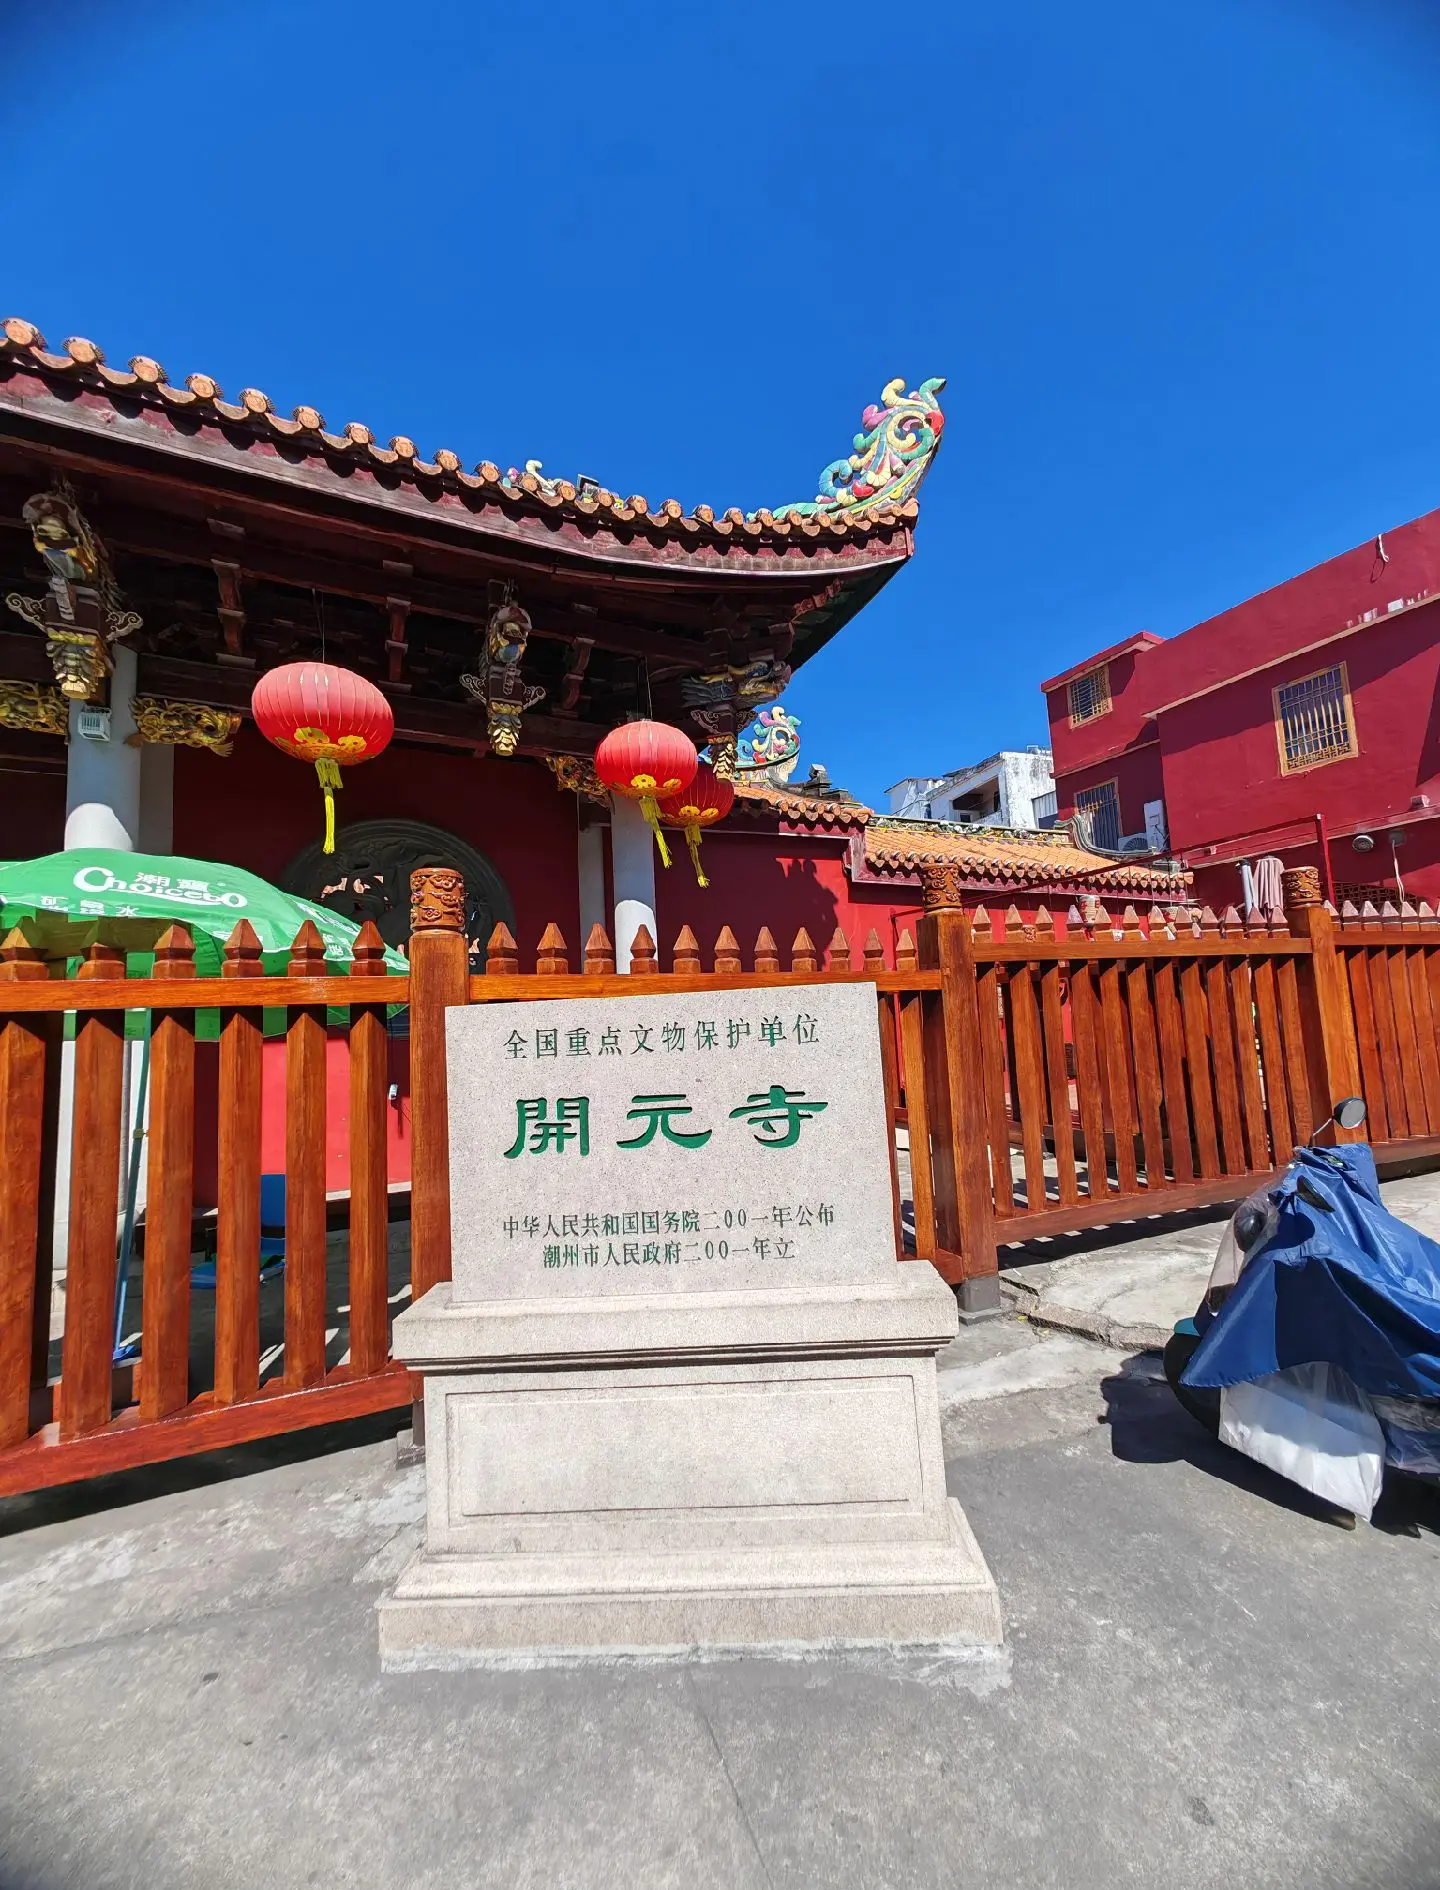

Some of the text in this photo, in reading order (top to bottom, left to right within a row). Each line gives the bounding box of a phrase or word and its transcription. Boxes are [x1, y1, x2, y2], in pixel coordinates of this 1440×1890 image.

[503, 1013, 820, 1060] 全国重点文物保护单位
[503, 1085, 828, 1160] 開元寺
